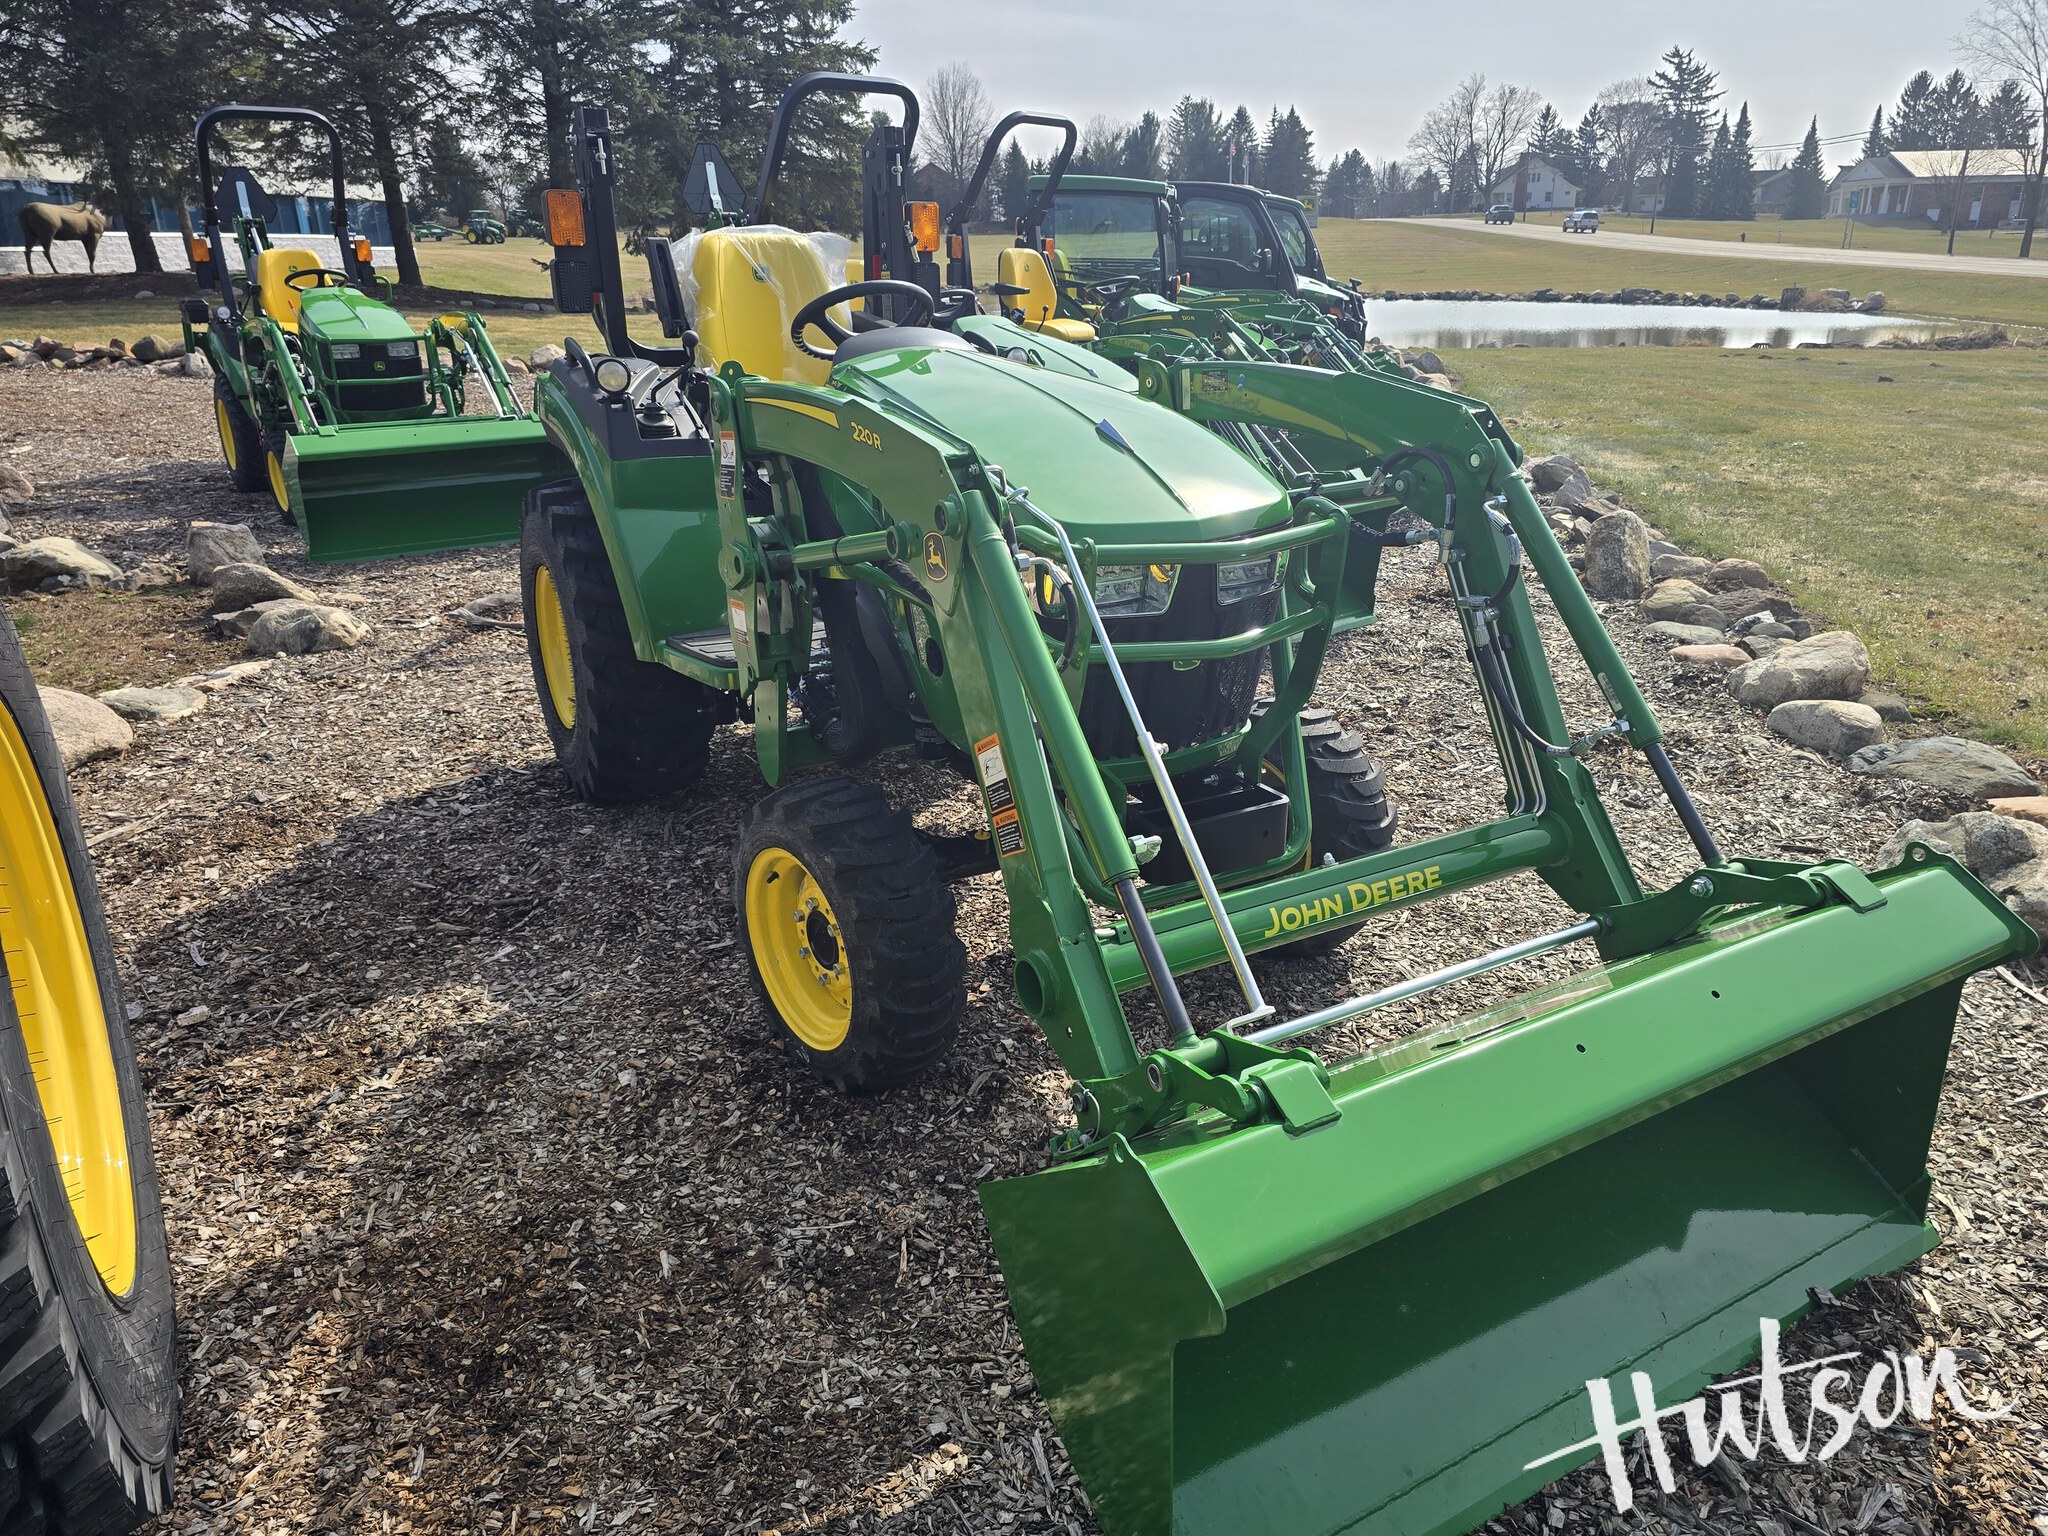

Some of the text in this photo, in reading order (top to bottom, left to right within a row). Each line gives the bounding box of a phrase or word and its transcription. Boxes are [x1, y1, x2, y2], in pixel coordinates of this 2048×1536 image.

[850, 421, 883, 452] 220R
[1264, 865, 1443, 938] JOHN DEERE
